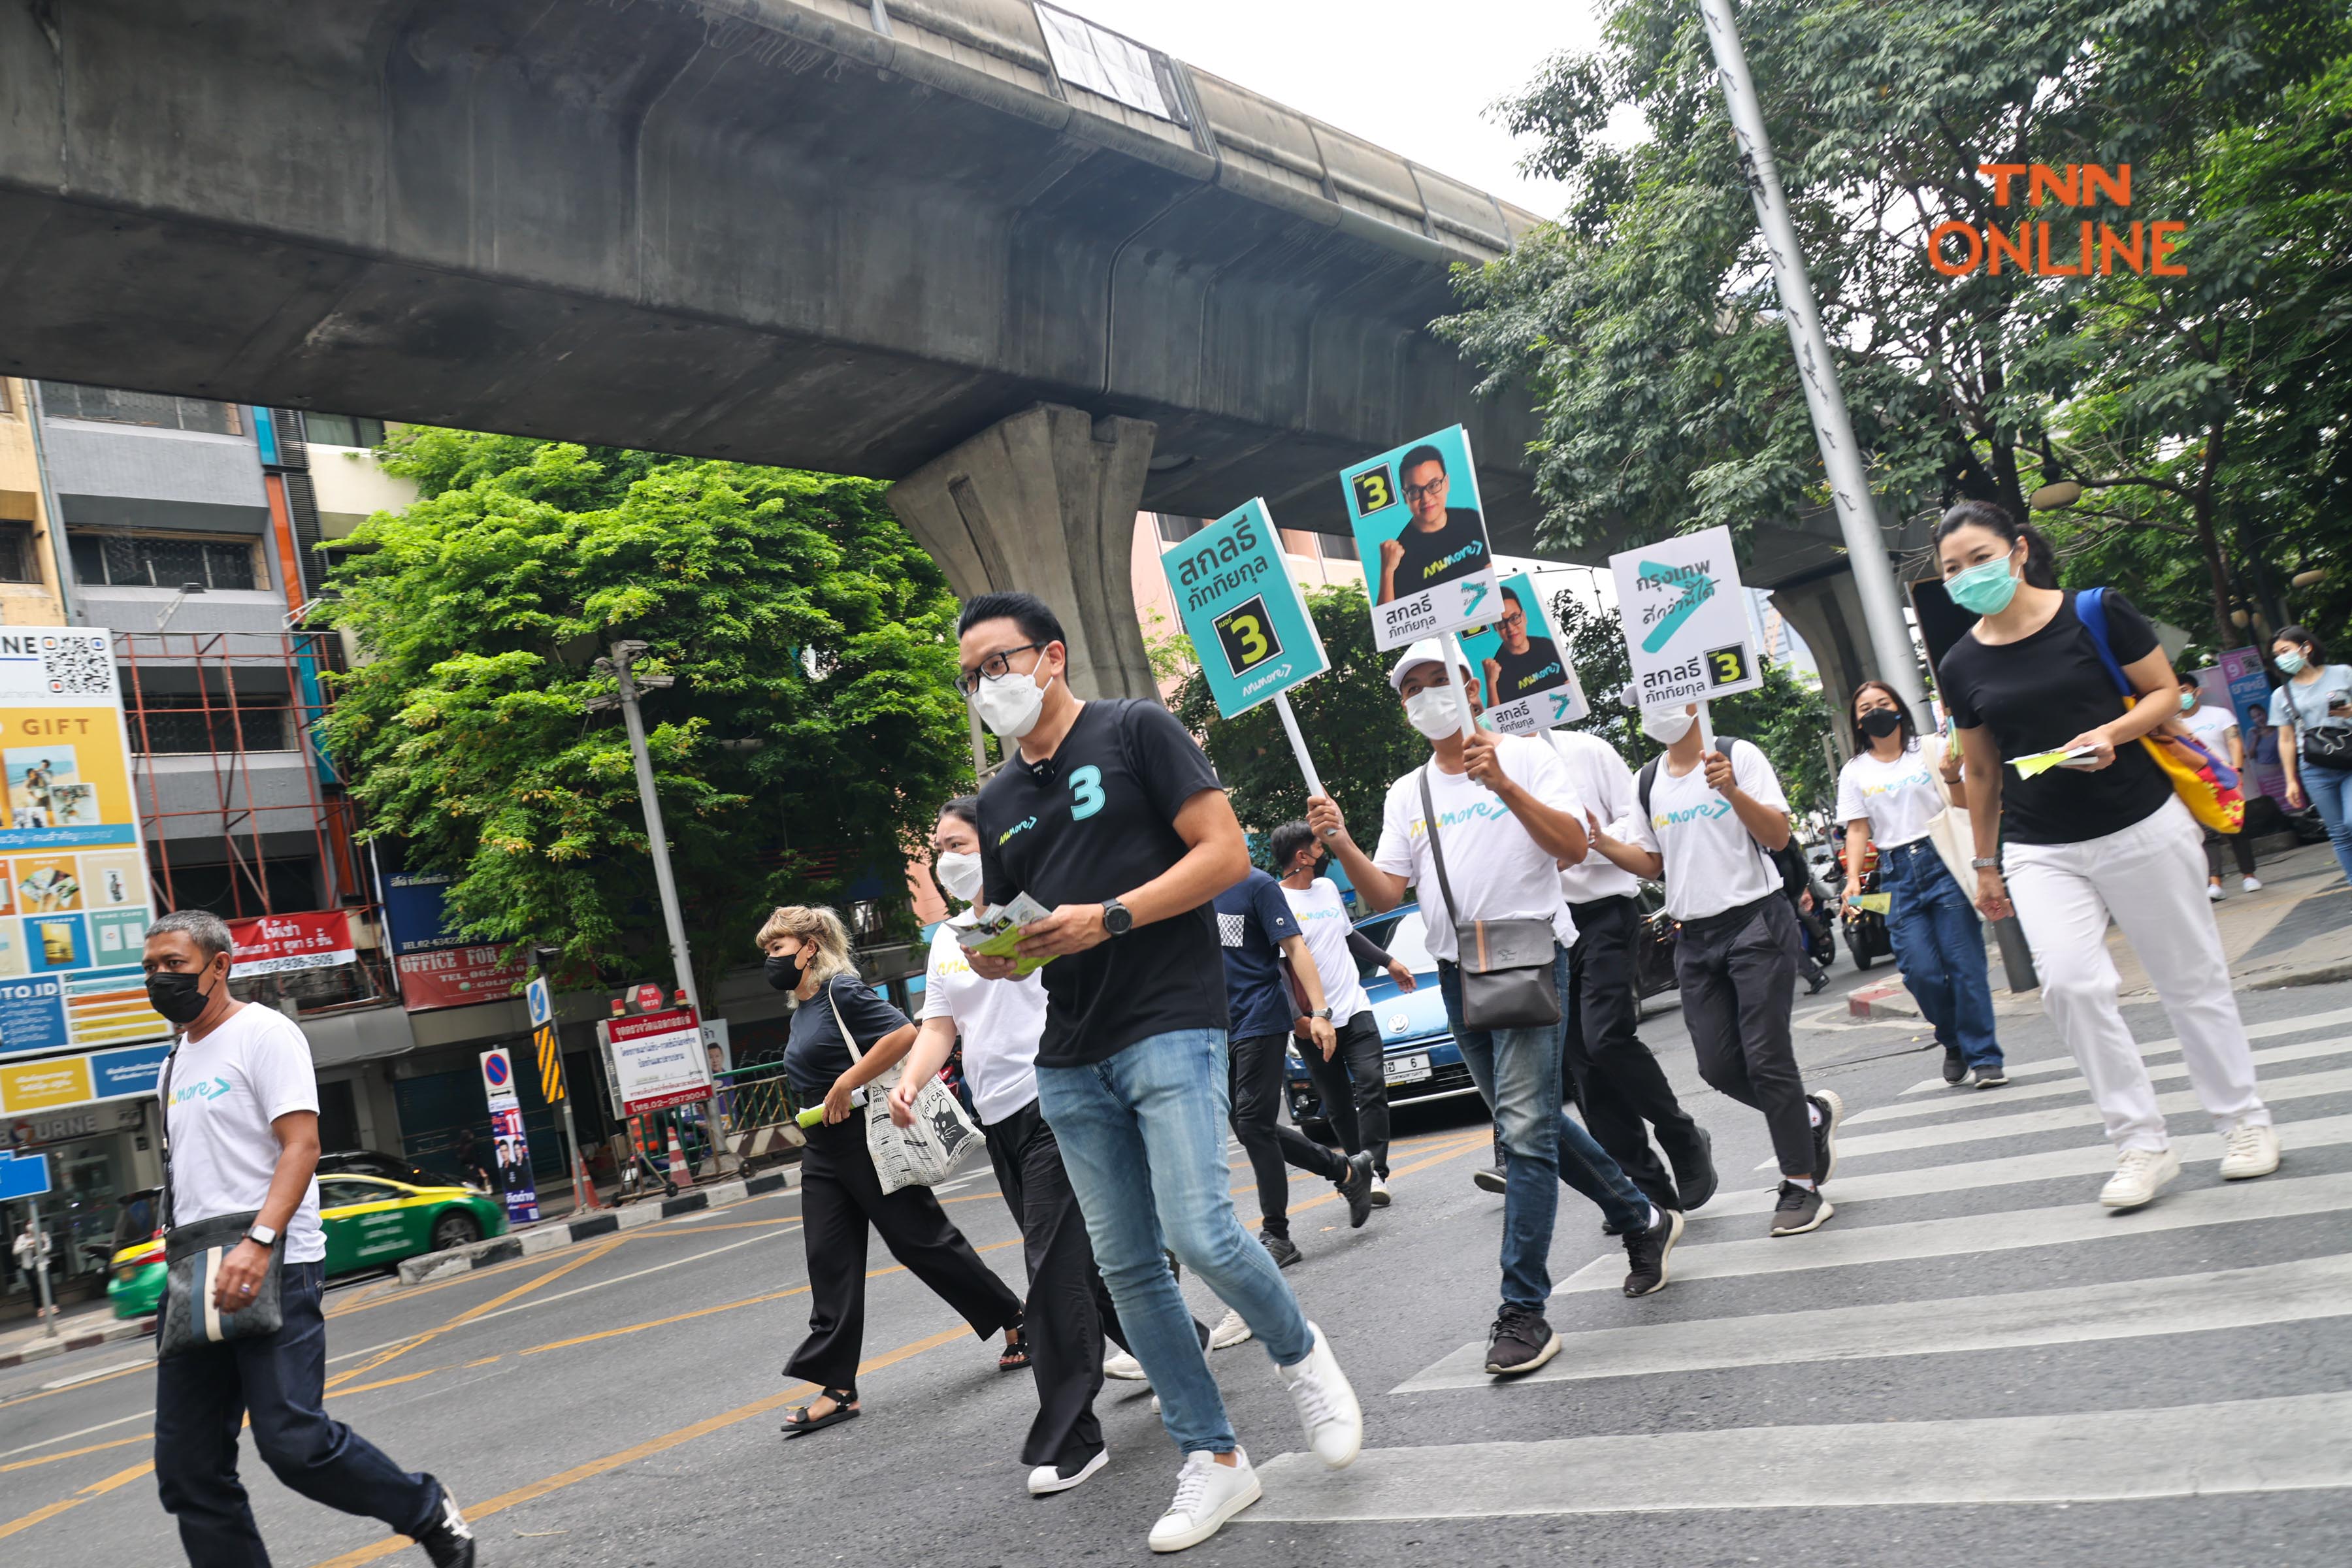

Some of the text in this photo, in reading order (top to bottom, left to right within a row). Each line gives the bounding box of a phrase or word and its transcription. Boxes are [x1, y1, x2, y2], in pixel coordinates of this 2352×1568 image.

[1362, 475, 1389, 511] 3
[1178, 514, 1257, 586] สกลธี
[1188, 555, 1269, 612] ภัททิยกุล
[1635, 559, 1710, 593] กรุงเทพ
[1386, 593, 1433, 625] สกลธี
[1388, 613, 1437, 640] ภัททิยกุล
[0, 636, 38, 654] NE
[1230, 614, 1268, 665] 3
[1642, 656, 1702, 689] สกลธี
[1716, 653, 1740, 683] 3
[1646, 680, 1705, 704] ภัททิยกุล
[1495, 700, 1530, 723] สกลธี
[22, 718, 90, 736] GIFT
[1499, 717, 1535, 734] ภัททิยกุล
[1068, 764, 1106, 821] 3
[257, 919, 301, 939] ให้เช่า
[272, 941, 281, 951] 1
[306, 937, 314, 947] 5
[399, 951, 457, 973] OFFICE
[466, 947, 498, 966] FOR
[0, 982, 57, 999] TO ID
[1411, 1058, 1417, 1068] 6
[921, 1100, 931, 1120] LOST
[931, 1090, 945, 1102] CAT
[506, 1113, 523, 1134] 11
[961, 1132, 977, 1144] FOUND
[892, 1177, 907, 1187] 2015
